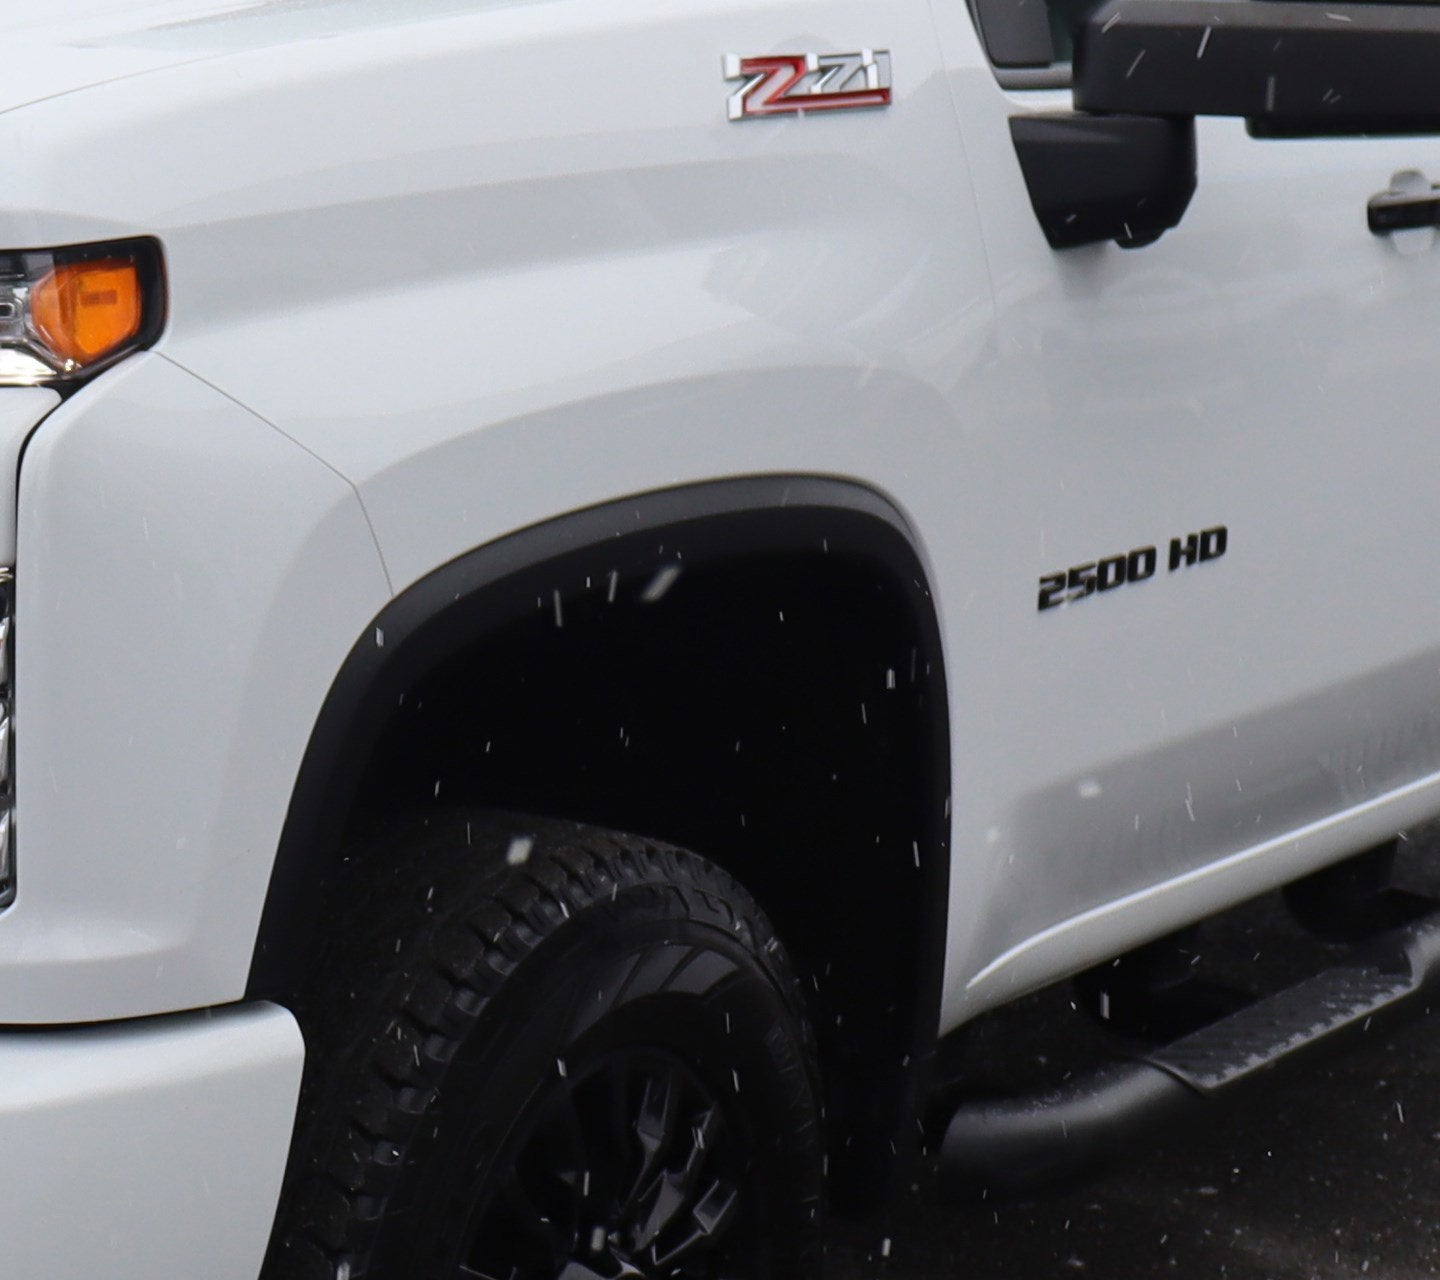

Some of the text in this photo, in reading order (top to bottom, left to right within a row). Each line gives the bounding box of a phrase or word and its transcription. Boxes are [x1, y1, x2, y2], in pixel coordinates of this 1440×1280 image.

[722, 48, 892, 121] Z71
[1037, 525, 1228, 611] 2500 HD
